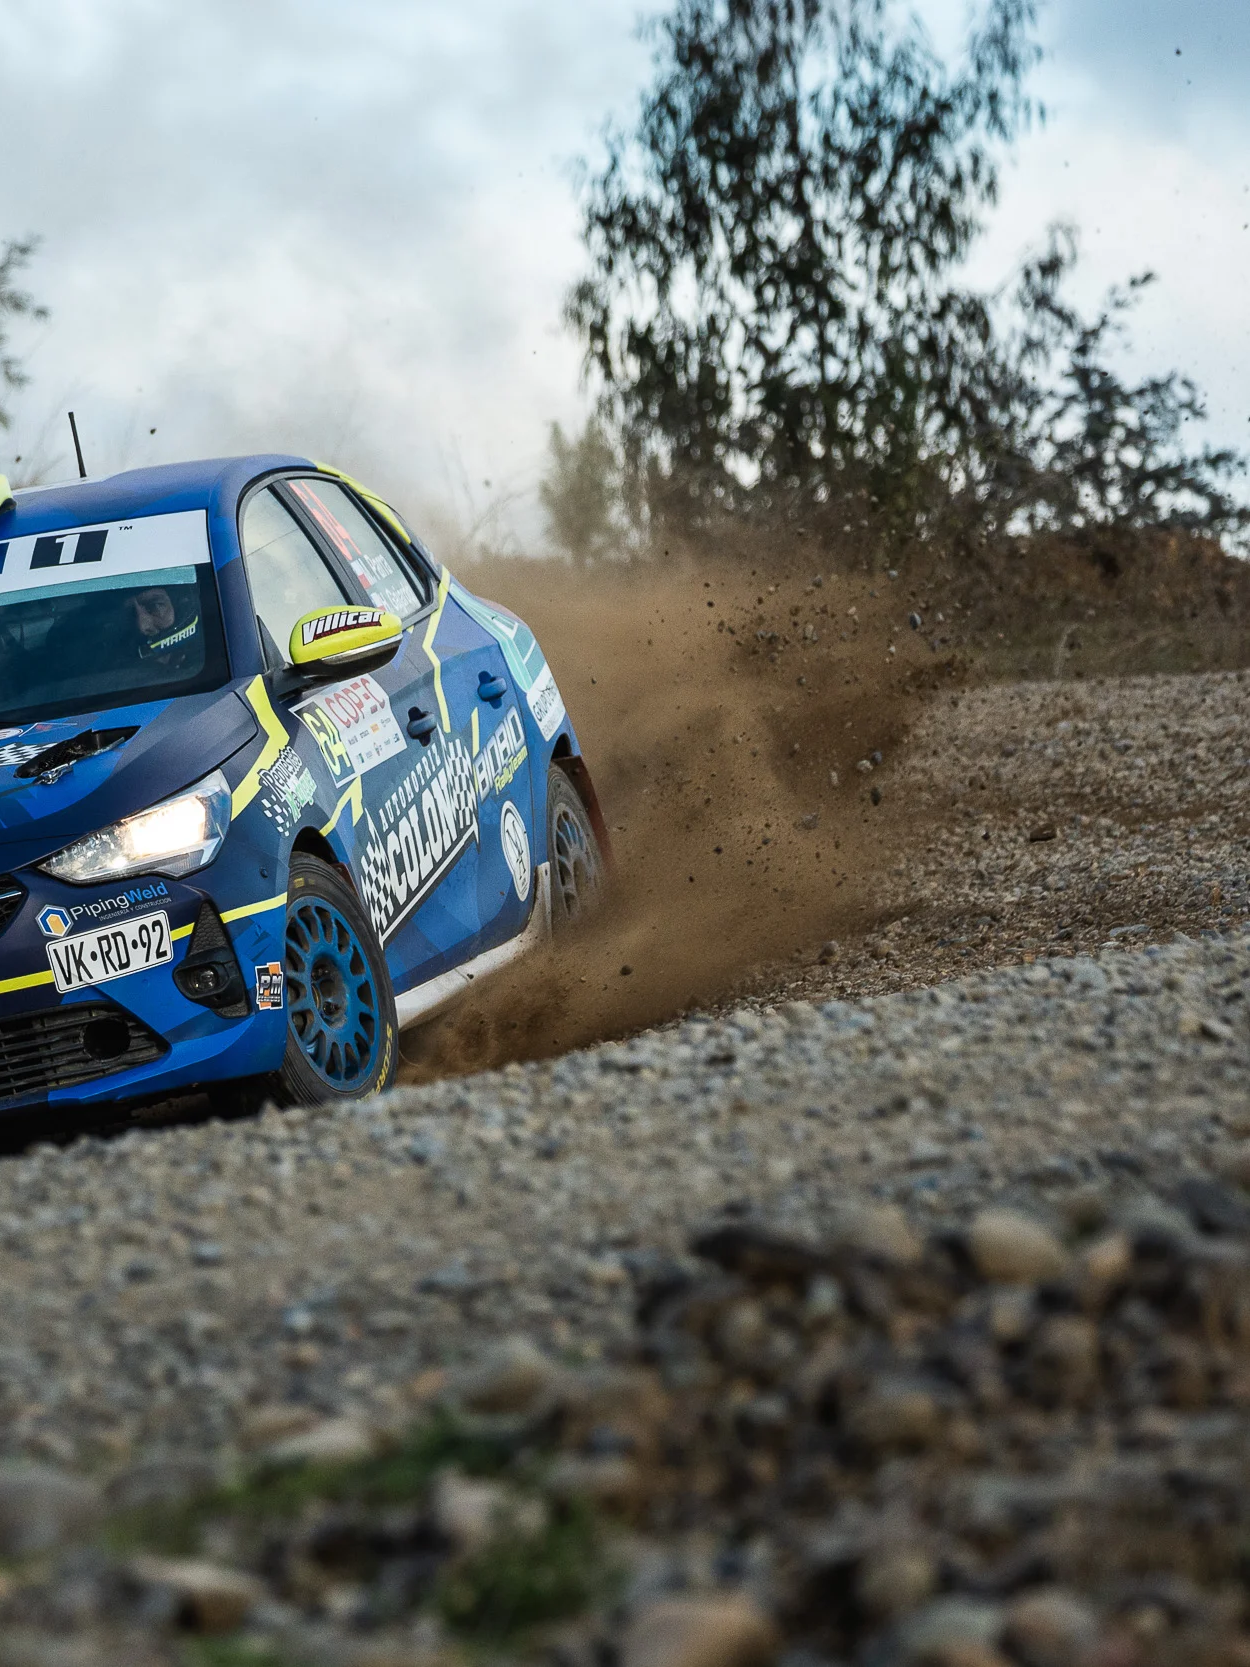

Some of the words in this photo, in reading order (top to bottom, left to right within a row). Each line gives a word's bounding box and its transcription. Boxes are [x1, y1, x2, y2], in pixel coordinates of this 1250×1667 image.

[159, 624, 196, 649] MARIO
[302, 610, 385, 646] Villicar
[325, 678, 385, 729] COPEC
[302, 707, 351, 776] 64
[474, 705, 526, 802] BIOBIO
[259, 745, 303, 802] Repuestos
[378, 742, 442, 833] AUTOMOTRIZ
[386, 767, 458, 906] COLON
[70, 882, 169, 920] PipingWeld
